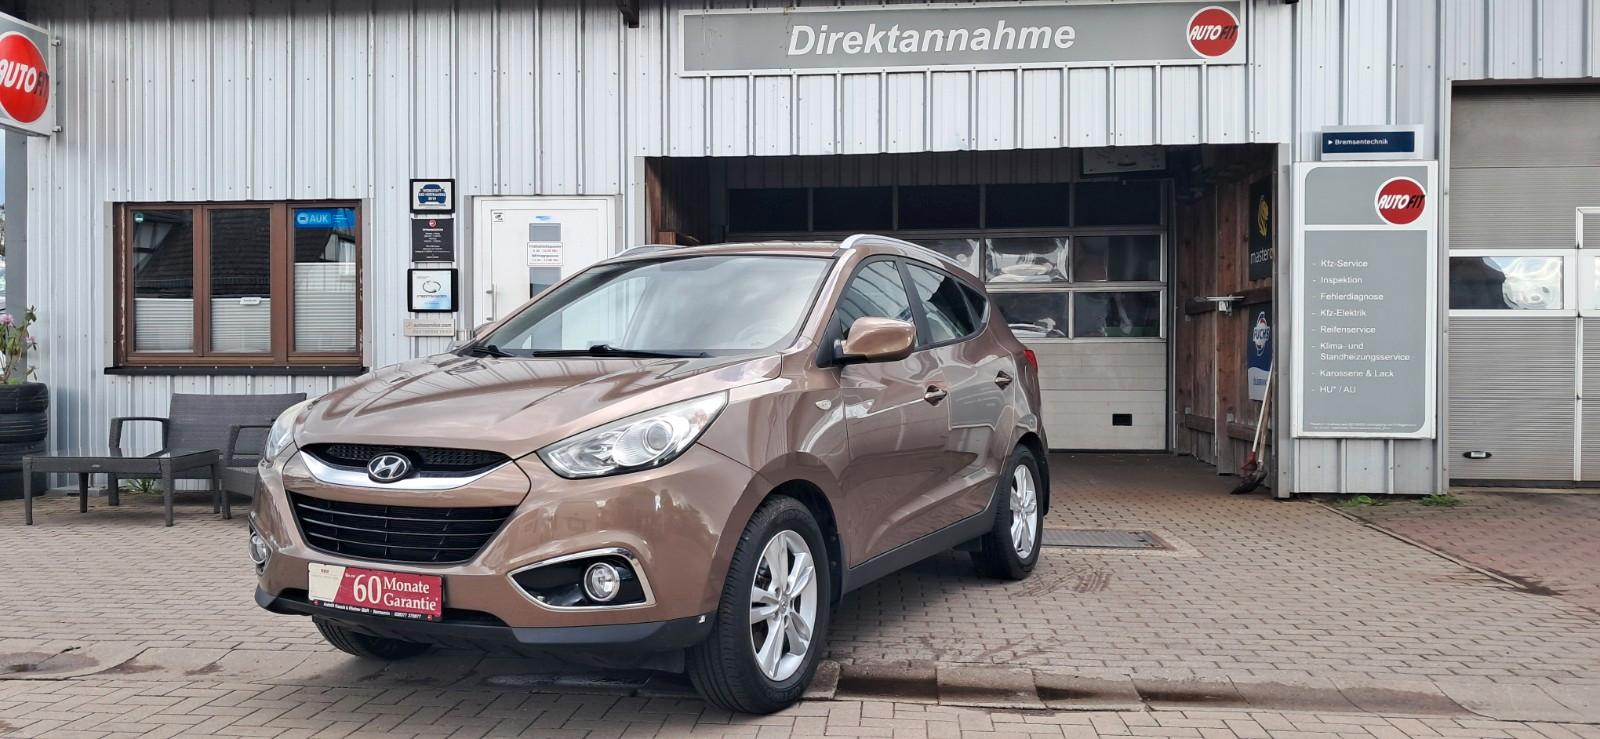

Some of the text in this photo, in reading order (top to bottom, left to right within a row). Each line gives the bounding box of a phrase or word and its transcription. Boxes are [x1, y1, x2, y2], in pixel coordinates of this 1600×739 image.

[1190, 25, 1239, 41] AUTOFIT
[788, 21, 1076, 55] Direktannahme
[1378, 194, 1426, 210] AUTOFIT
[310, 214, 329, 223] AUK
[1320, 259, 1368, 268] Kfz-Service
[1320, 276, 1362, 285] Inspektion
[1320, 292, 1384, 302] Fehlerdiagnose
[1320, 309, 1366, 317] Kfz-Elektrik
[1320, 325, 1376, 334] Reifenservice
[1348, 342, 1364, 350] und
[1320, 352, 1410, 362] Standheizungsservice
[1320, 369, 1394, 377] Karosserie & Lack
[353, 574, 430, 604] 60 Monate
